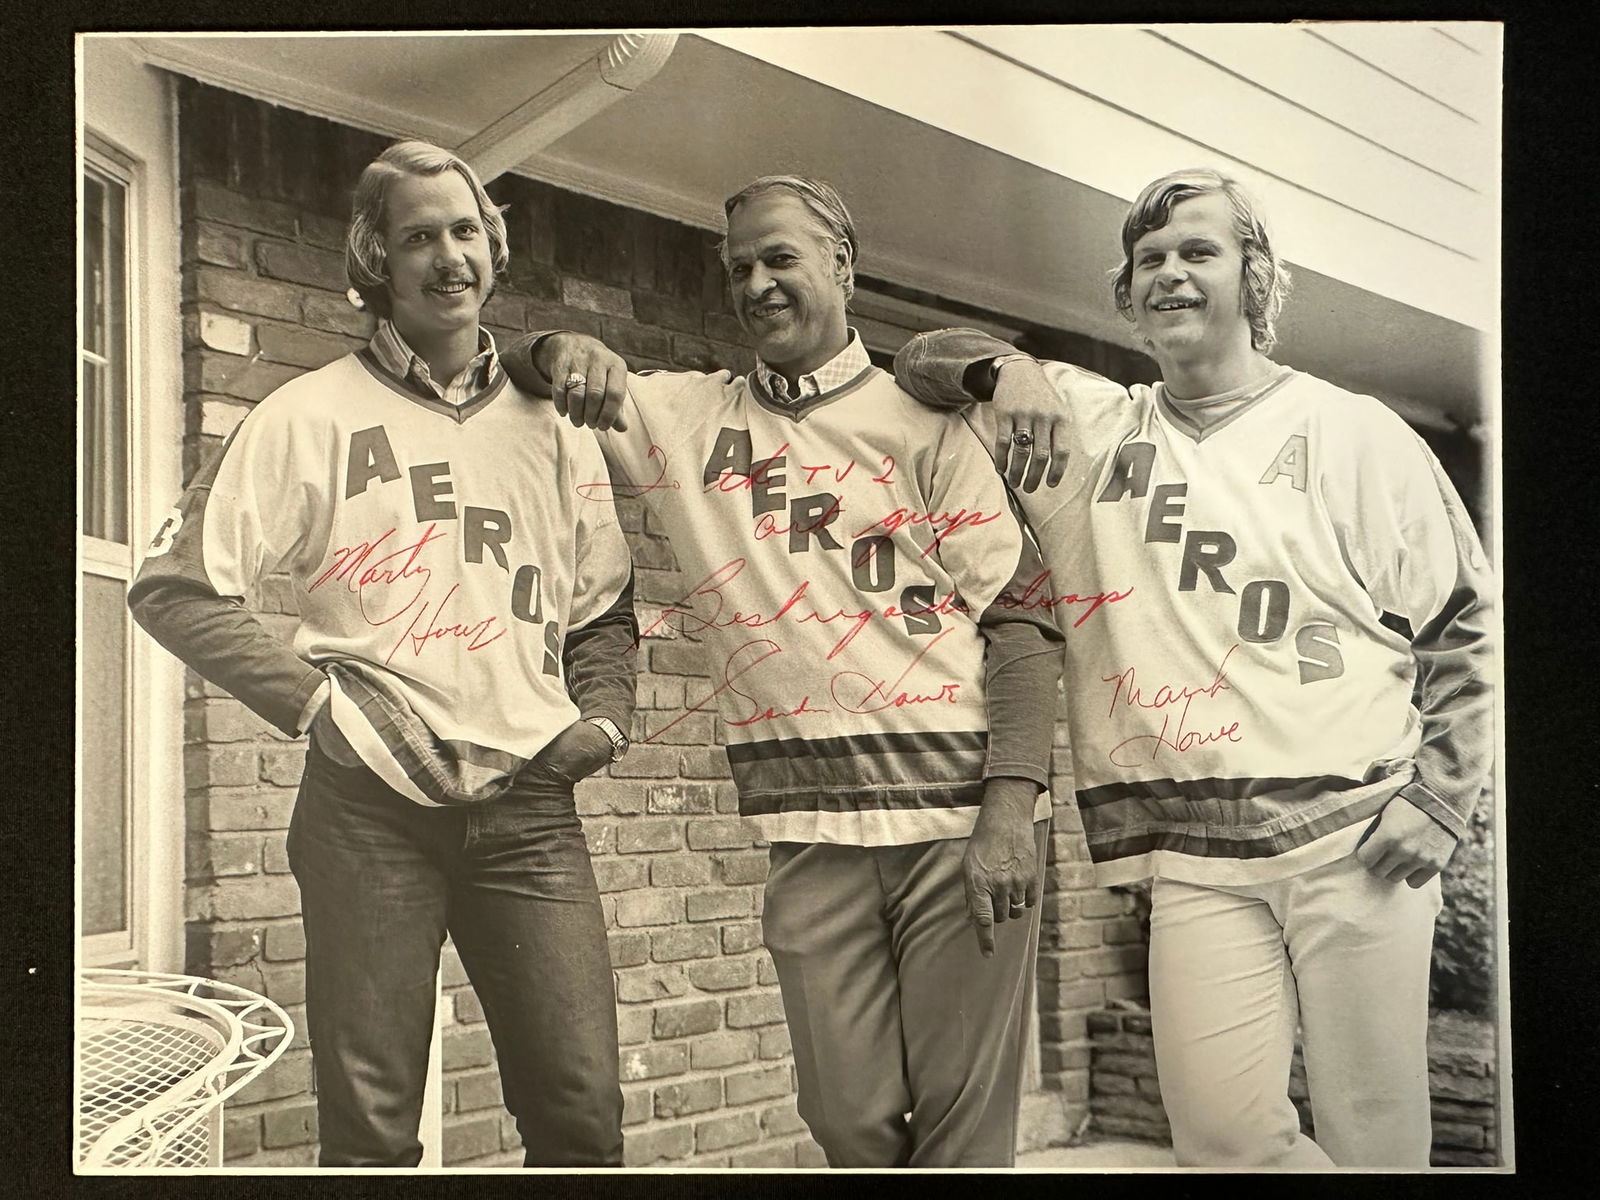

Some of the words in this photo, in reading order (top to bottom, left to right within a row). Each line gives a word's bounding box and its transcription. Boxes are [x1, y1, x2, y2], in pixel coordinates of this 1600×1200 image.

[1258, 434, 1309, 493] A
[308, 523, 447, 626] Marty
[346, 425, 560, 677] AEROS
[703, 427, 941, 636] AEROS
[851, 508, 1002, 569] guys
[1097, 441, 1345, 684] AEROS
[385, 584, 508, 665] Howe
[620, 558, 811, 655] Best
[994, 569, 1135, 628] always
[1109, 695, 1243, 768] Howe
